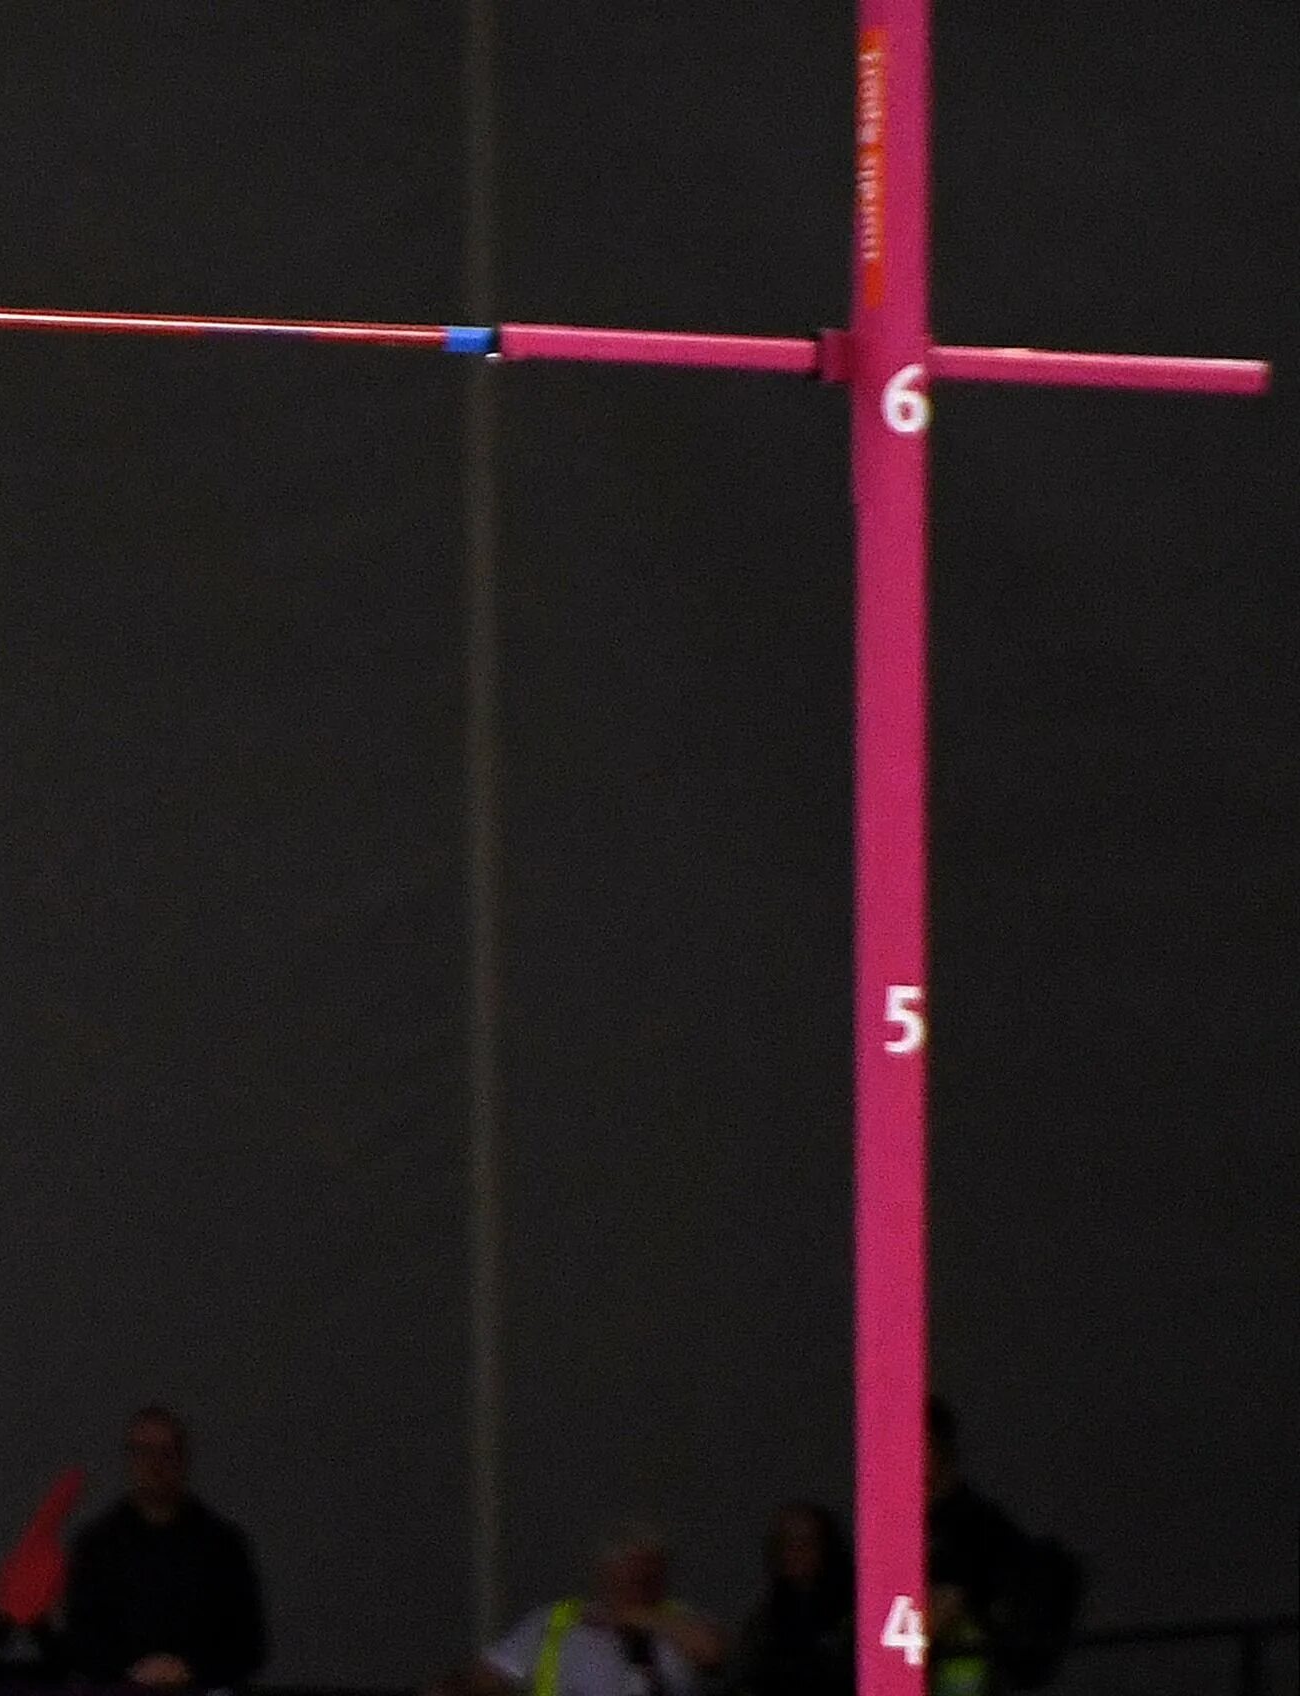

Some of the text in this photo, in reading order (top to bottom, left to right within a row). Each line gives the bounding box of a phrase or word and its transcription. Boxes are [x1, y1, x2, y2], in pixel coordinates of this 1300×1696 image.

[882, 363, 928, 432] 6
[883, 985, 926, 1053] 5
[880, 1595, 928, 1665] 4
